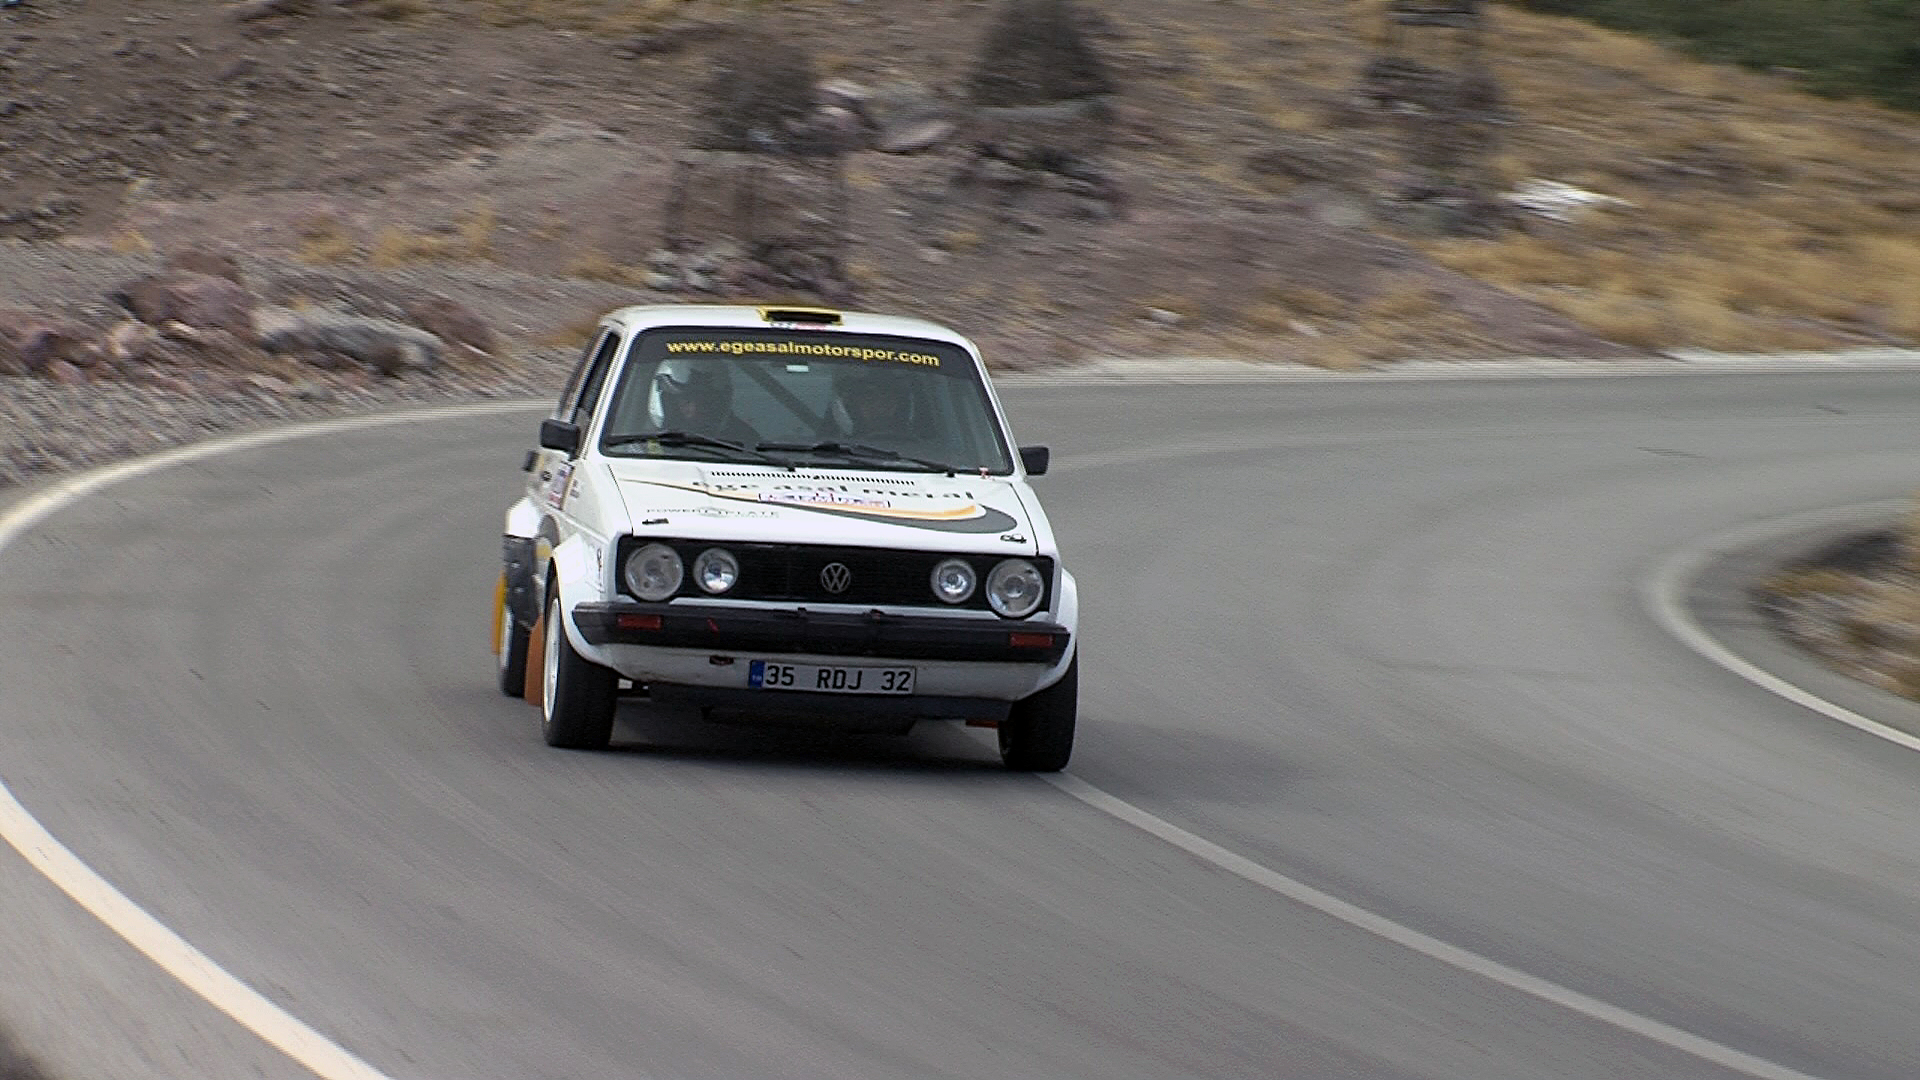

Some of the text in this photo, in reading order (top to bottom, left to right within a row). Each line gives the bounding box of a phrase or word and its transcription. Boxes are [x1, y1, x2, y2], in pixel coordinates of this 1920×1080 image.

[666, 340, 940, 367] www.egeasalmotorspor.com
[765, 665, 911, 692] 35 RDJ 32
